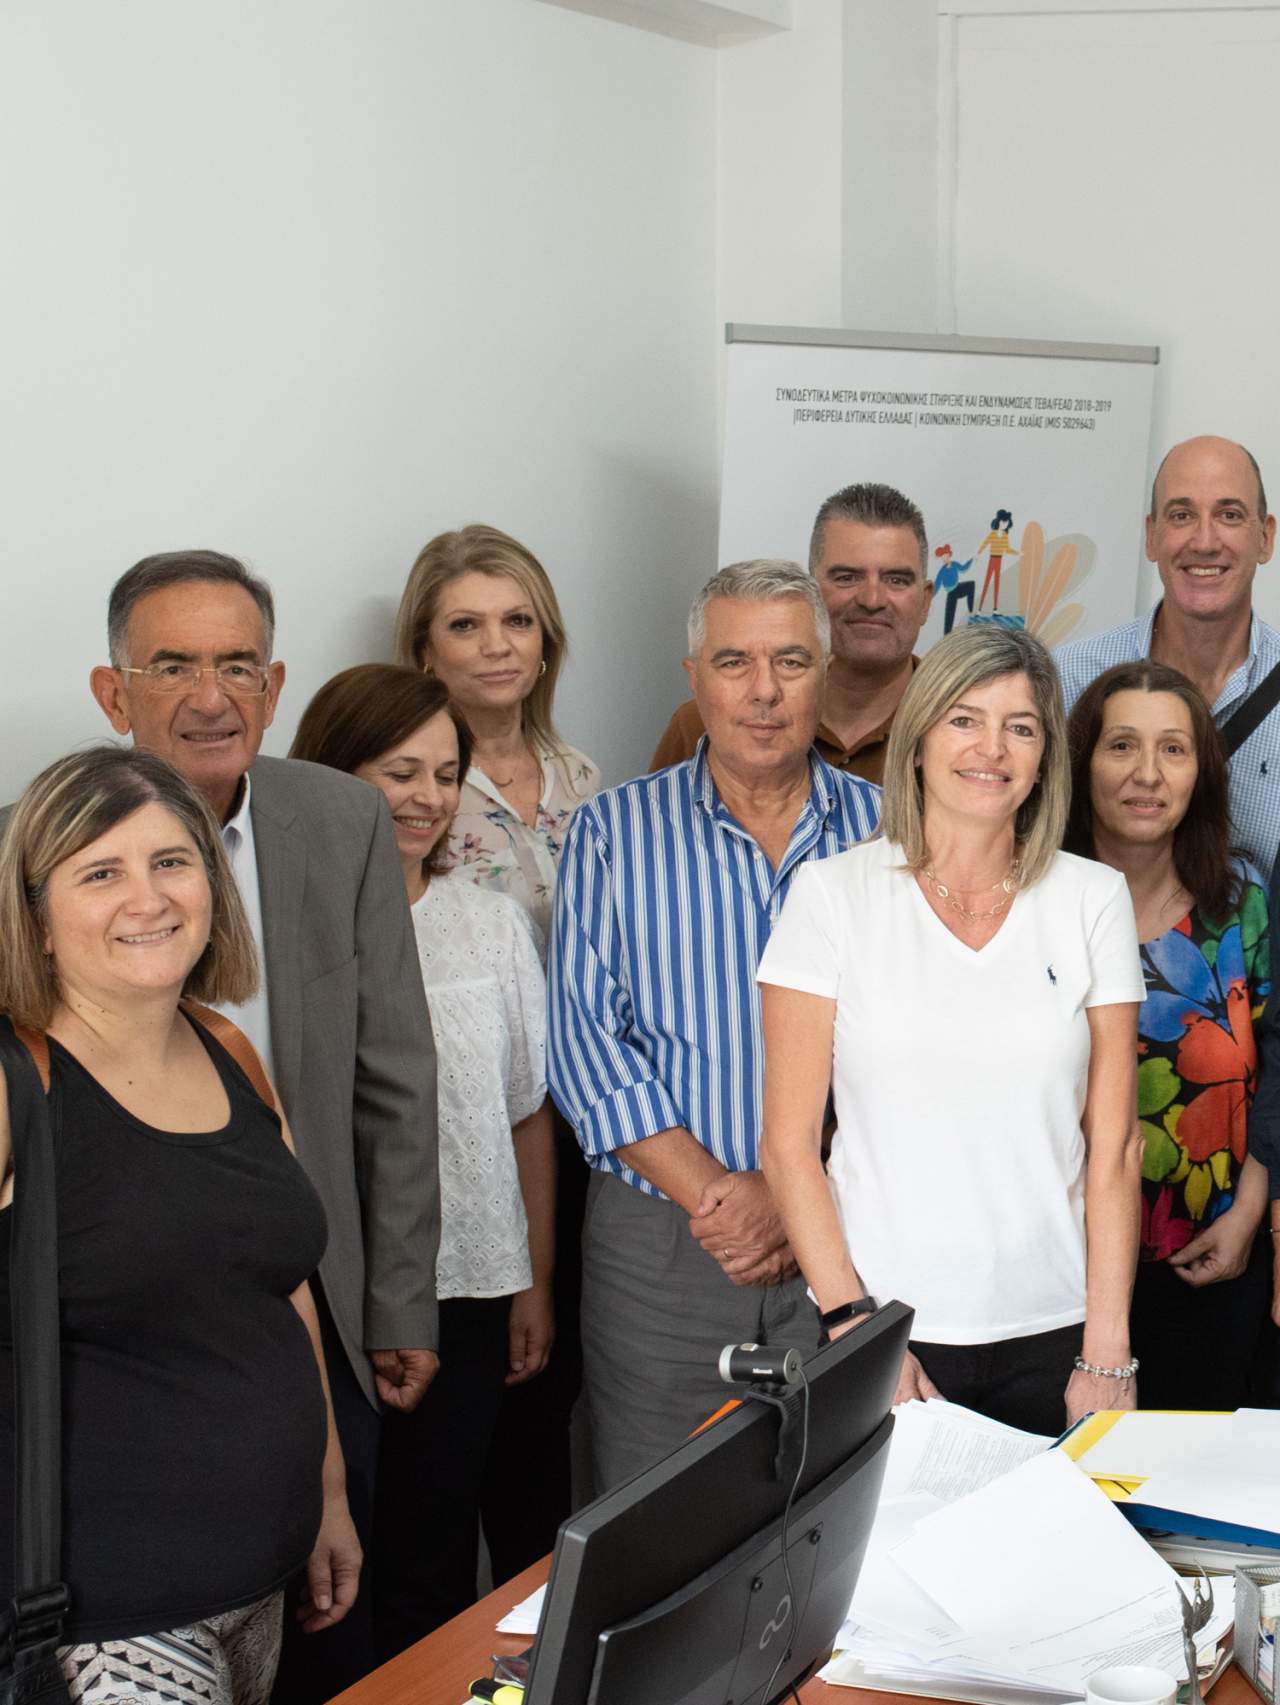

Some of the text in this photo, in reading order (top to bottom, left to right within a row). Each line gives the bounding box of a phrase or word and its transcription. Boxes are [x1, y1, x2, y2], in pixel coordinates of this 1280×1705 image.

[776, 387, 830, 402] ΣΥΝΟΔΕΥΤΙΚΑ
[832, 389, 858, 403] ΜΕΤΡΑ
[964, 395, 977, 407] ΚΑΙ
[1074, 399, 1112, 412] 2018-2019
[845, 410, 877, 423] ΔΥΤΙΚΗΣ
[879, 411, 912, 424] ΕΛΛΑΔΑΣ
